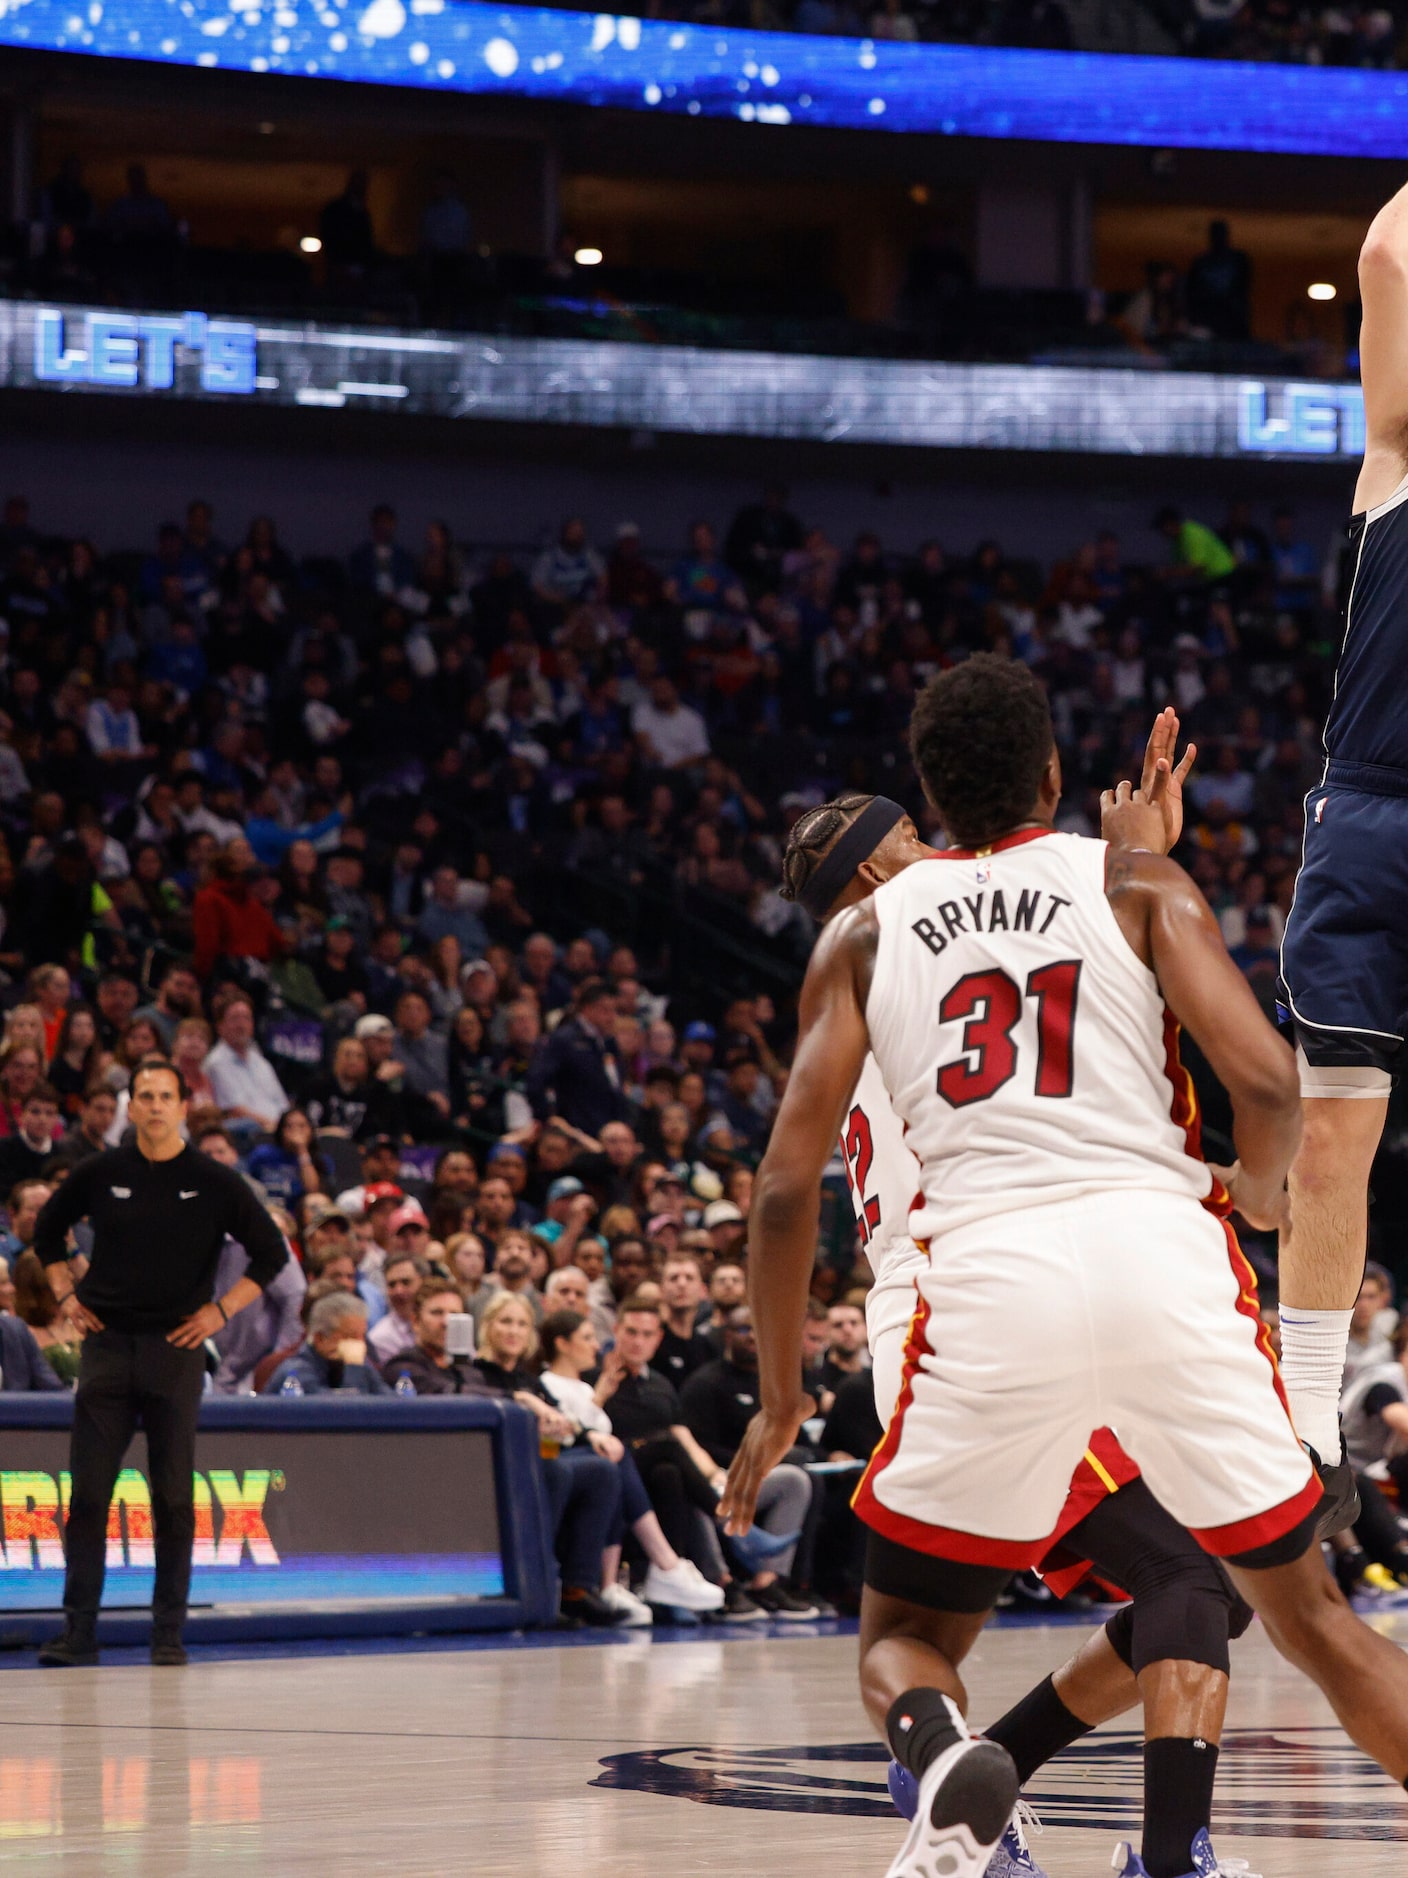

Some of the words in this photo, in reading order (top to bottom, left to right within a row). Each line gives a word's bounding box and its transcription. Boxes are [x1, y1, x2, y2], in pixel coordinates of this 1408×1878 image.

[34, 309, 256, 394] LET'S
[1237, 381, 1365, 455] LET
[911, 888, 1073, 956] BRYANT
[936, 959, 1084, 1110] 31
